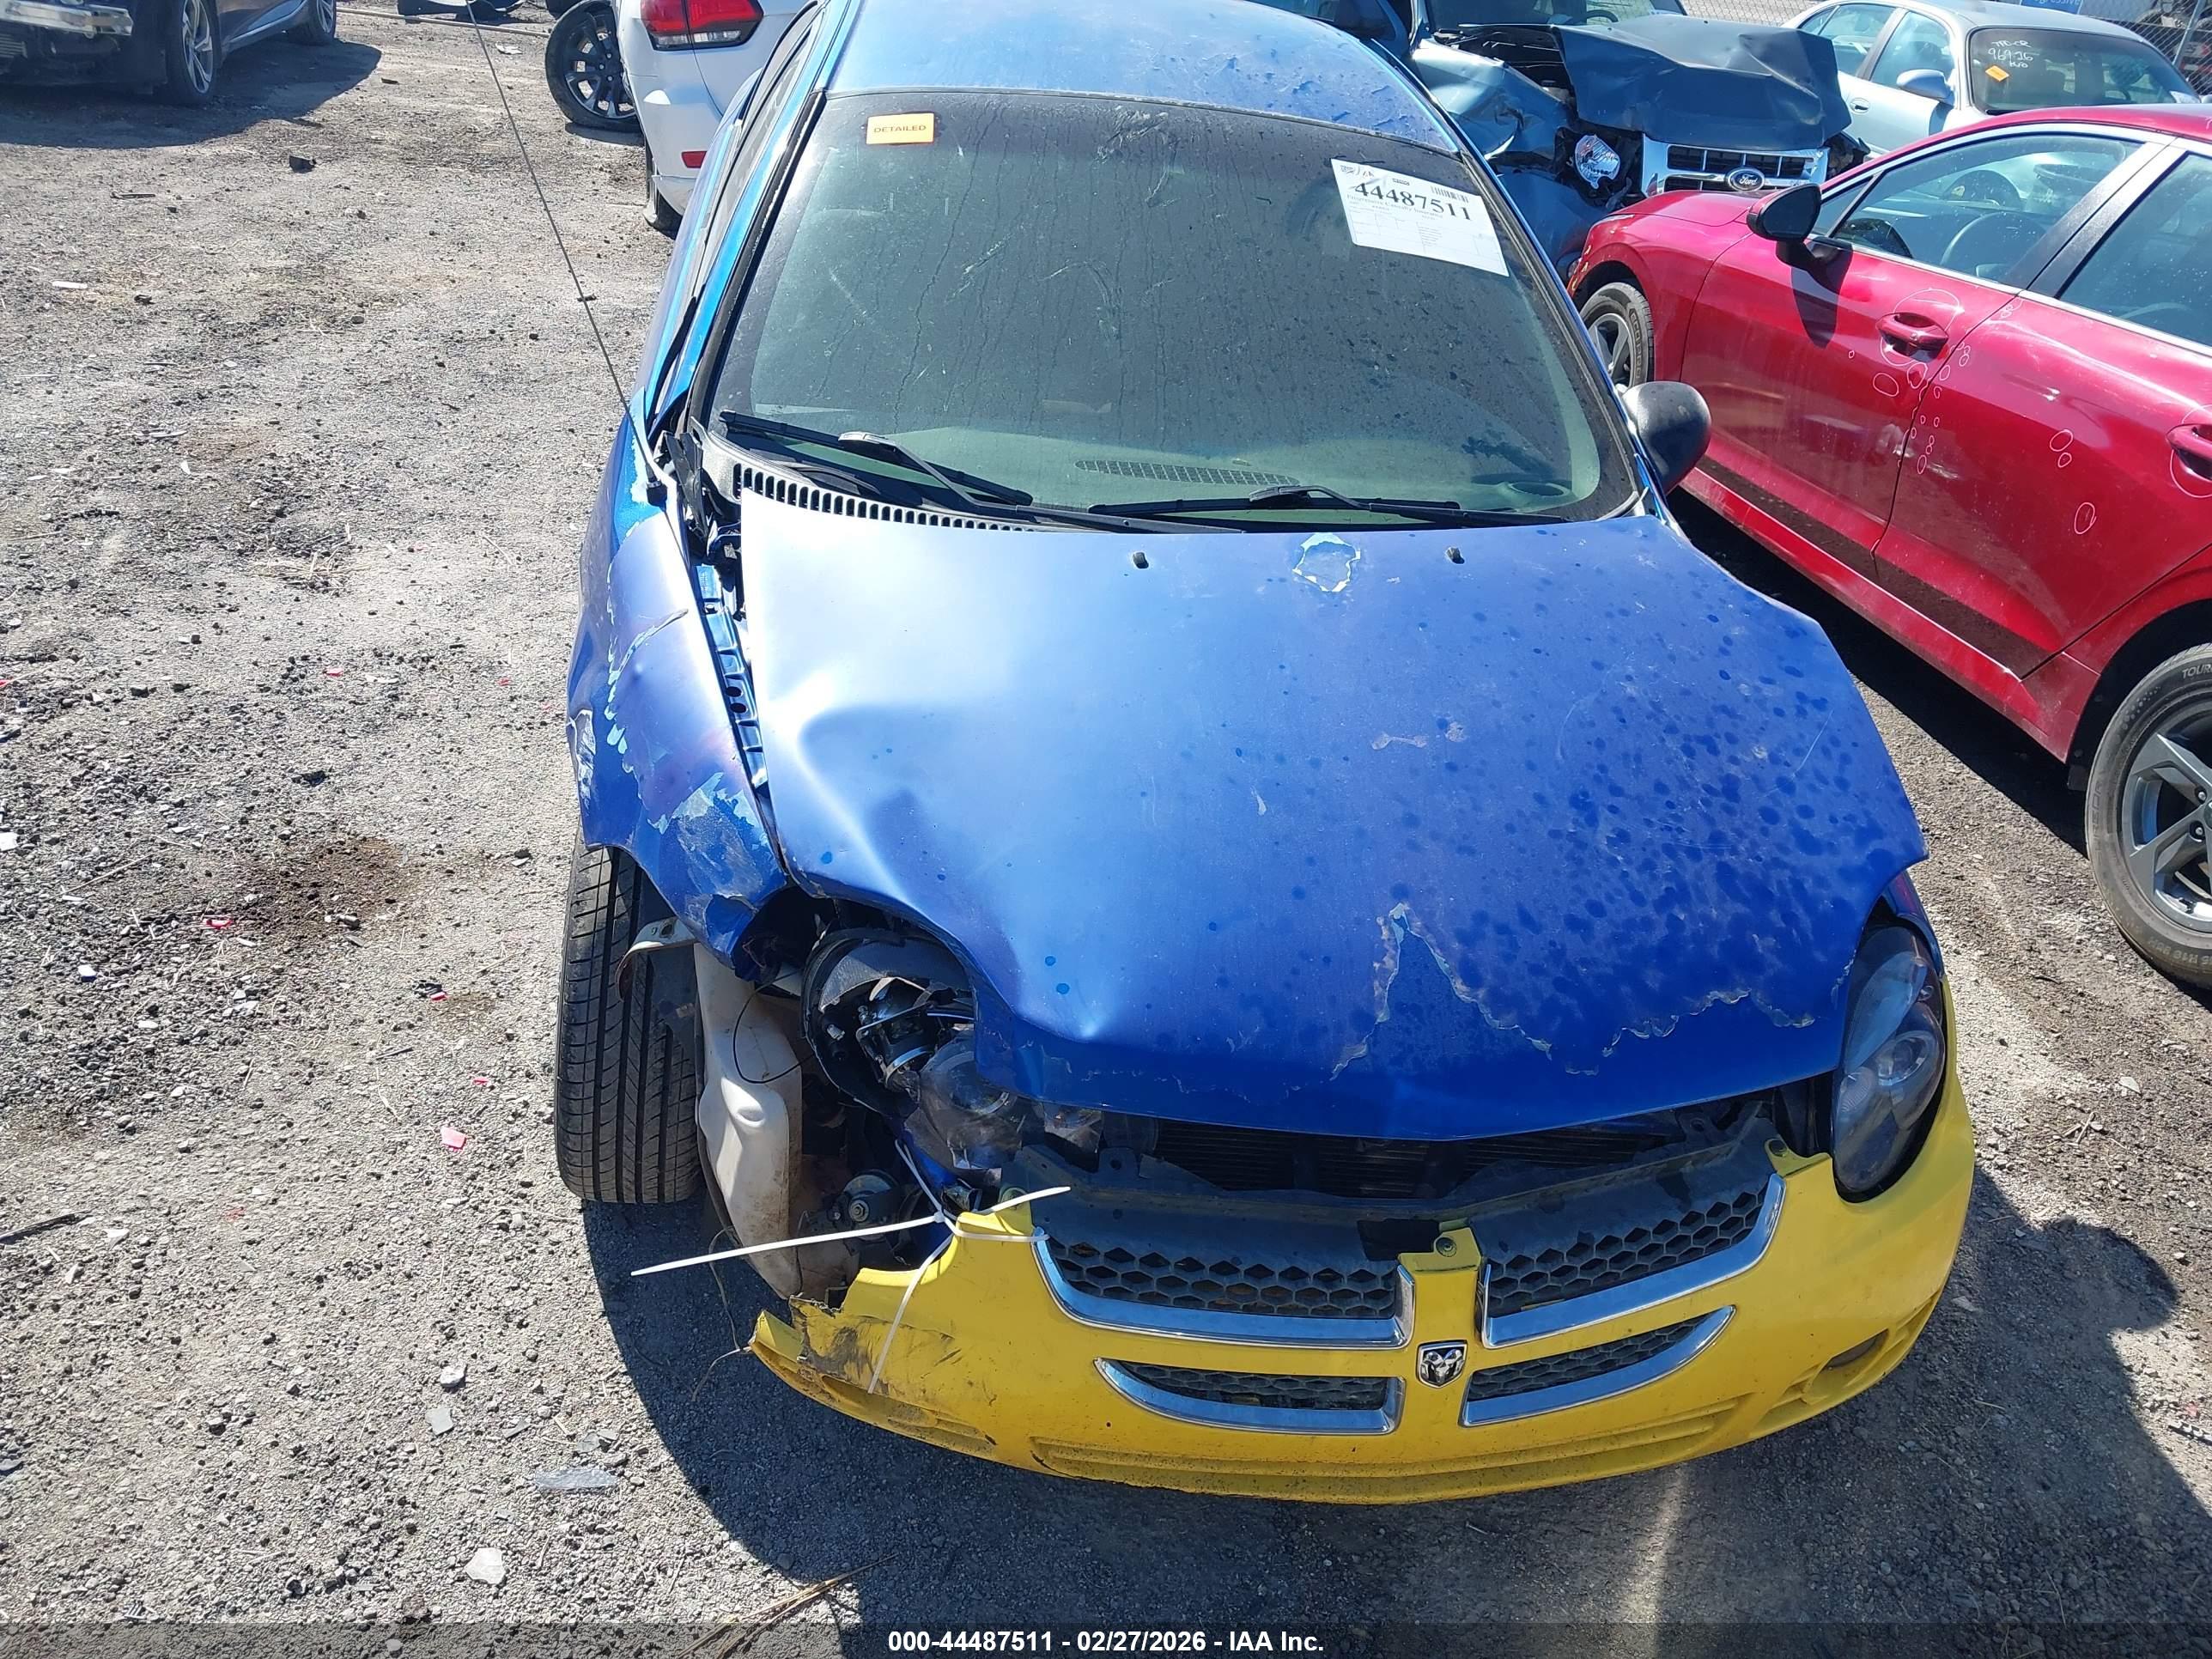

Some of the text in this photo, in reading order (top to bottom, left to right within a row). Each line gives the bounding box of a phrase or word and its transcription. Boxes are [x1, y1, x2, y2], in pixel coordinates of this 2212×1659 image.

[874, 125, 927, 133] DETAILED
[1739, 173, 1759, 185] Ford
[1354, 182, 1472, 221] 44487511
